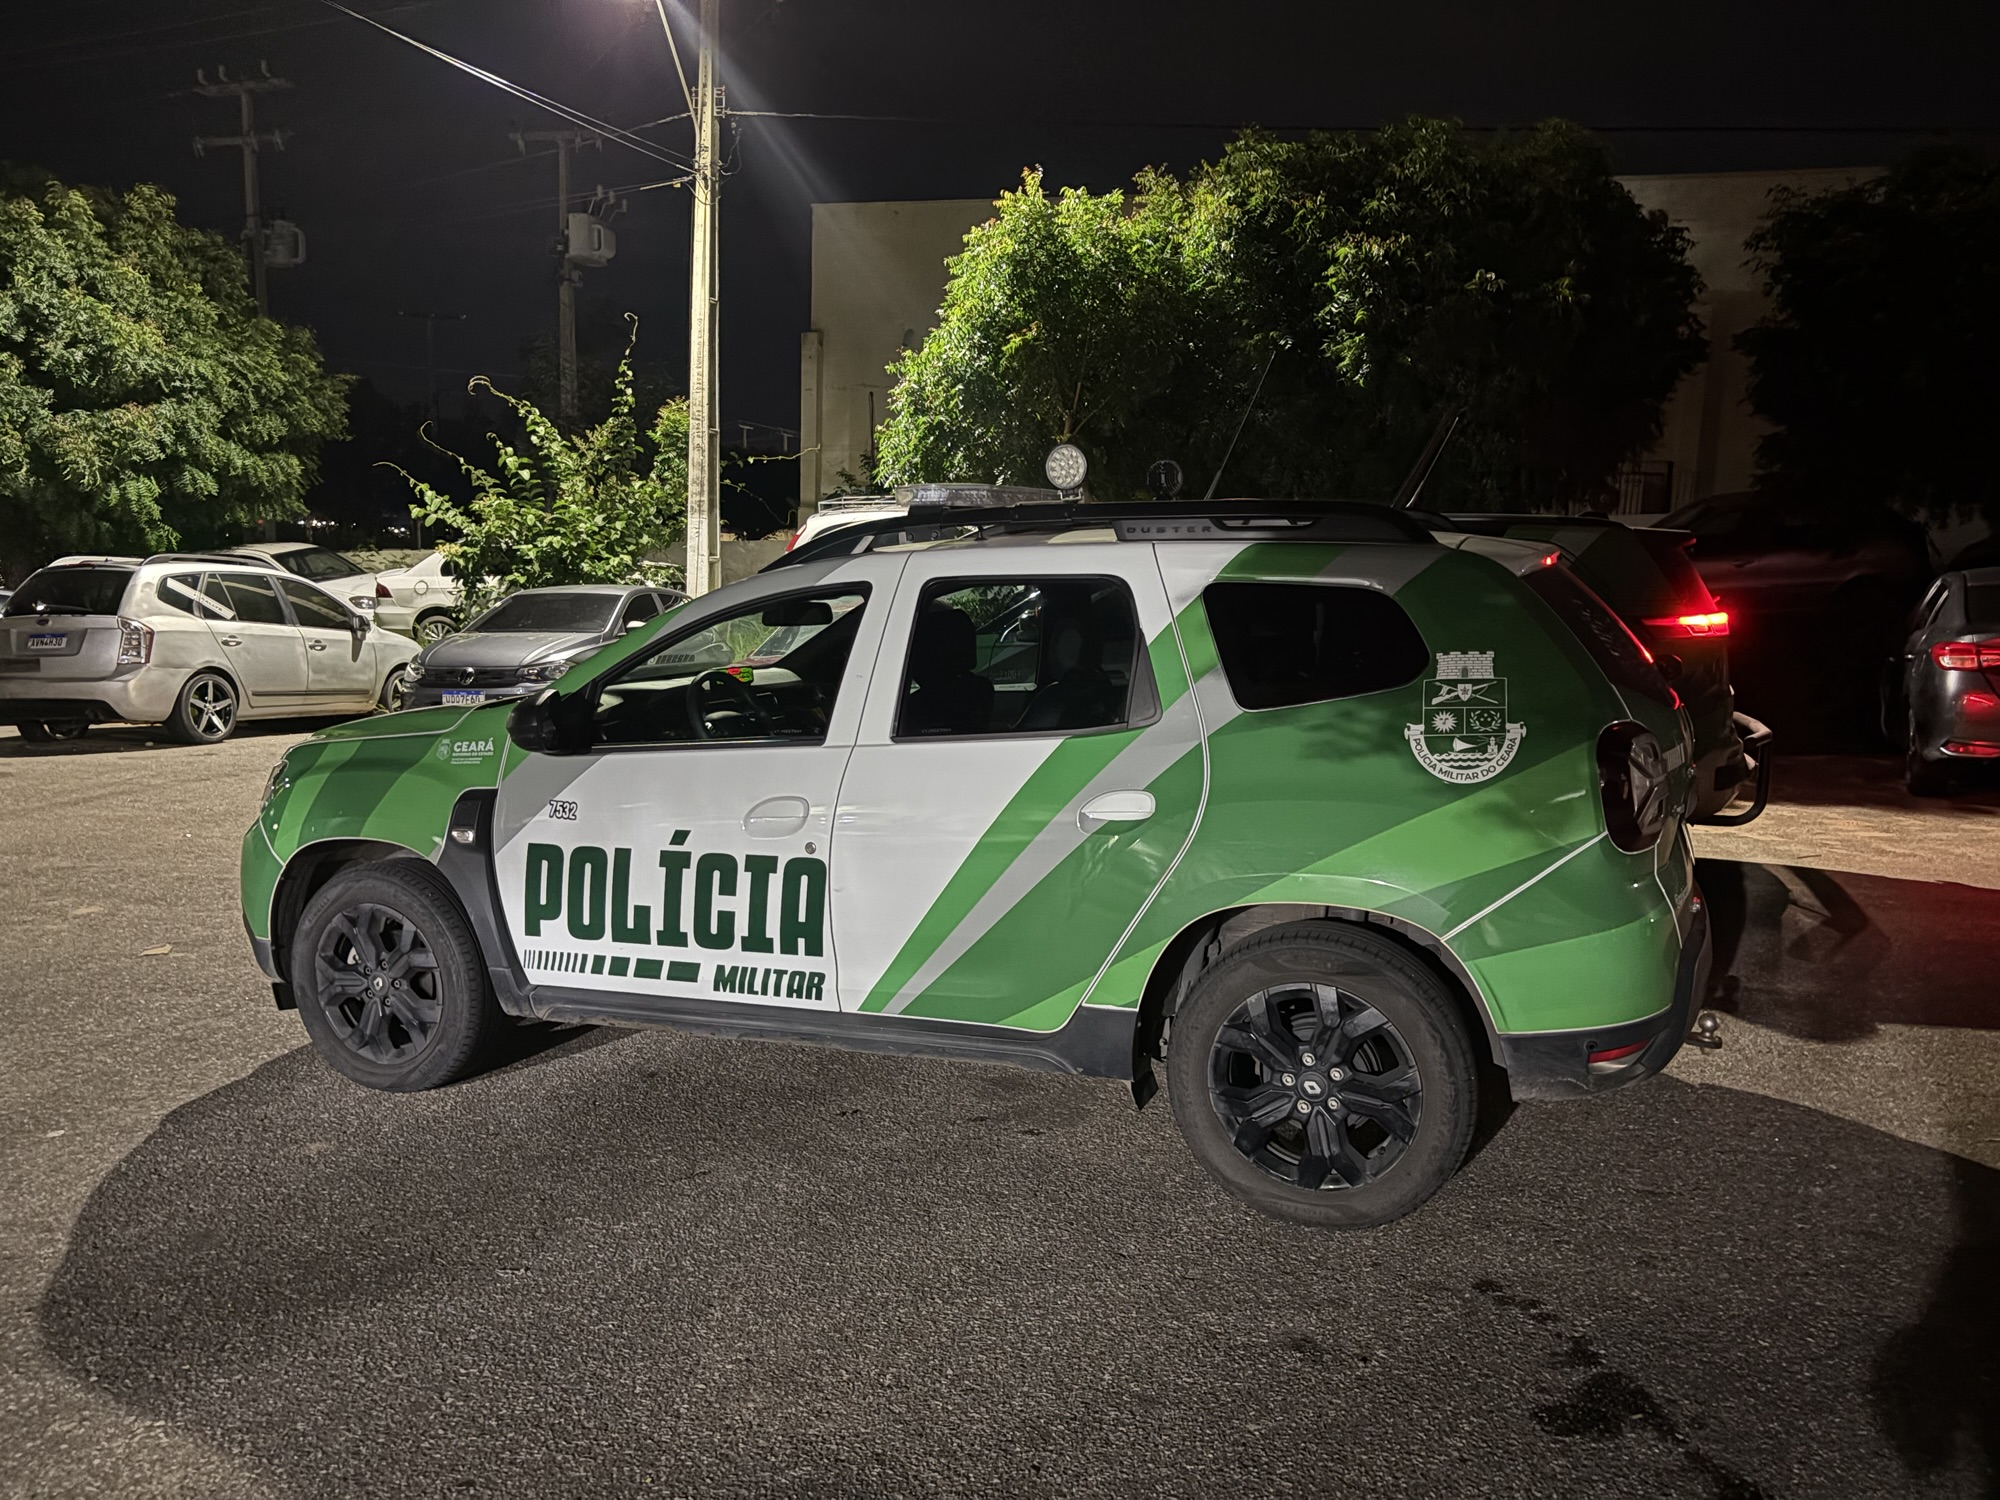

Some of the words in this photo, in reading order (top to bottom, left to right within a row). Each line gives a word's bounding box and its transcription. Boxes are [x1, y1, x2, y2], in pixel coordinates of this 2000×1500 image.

[1126, 525, 1213, 534] DUSTER
[453, 737, 495, 752] CEARÁ
[1412, 737, 1438, 772] POLÍCIA
[1437, 766, 1480, 781] MILITAR
[1481, 766, 1497, 778] DO
[1496, 736, 1518, 767] CEARÁ
[549, 799, 578, 821] 7532
[524, 829, 828, 958] POLÍCIA
[713, 964, 827, 1001] MILITAR
